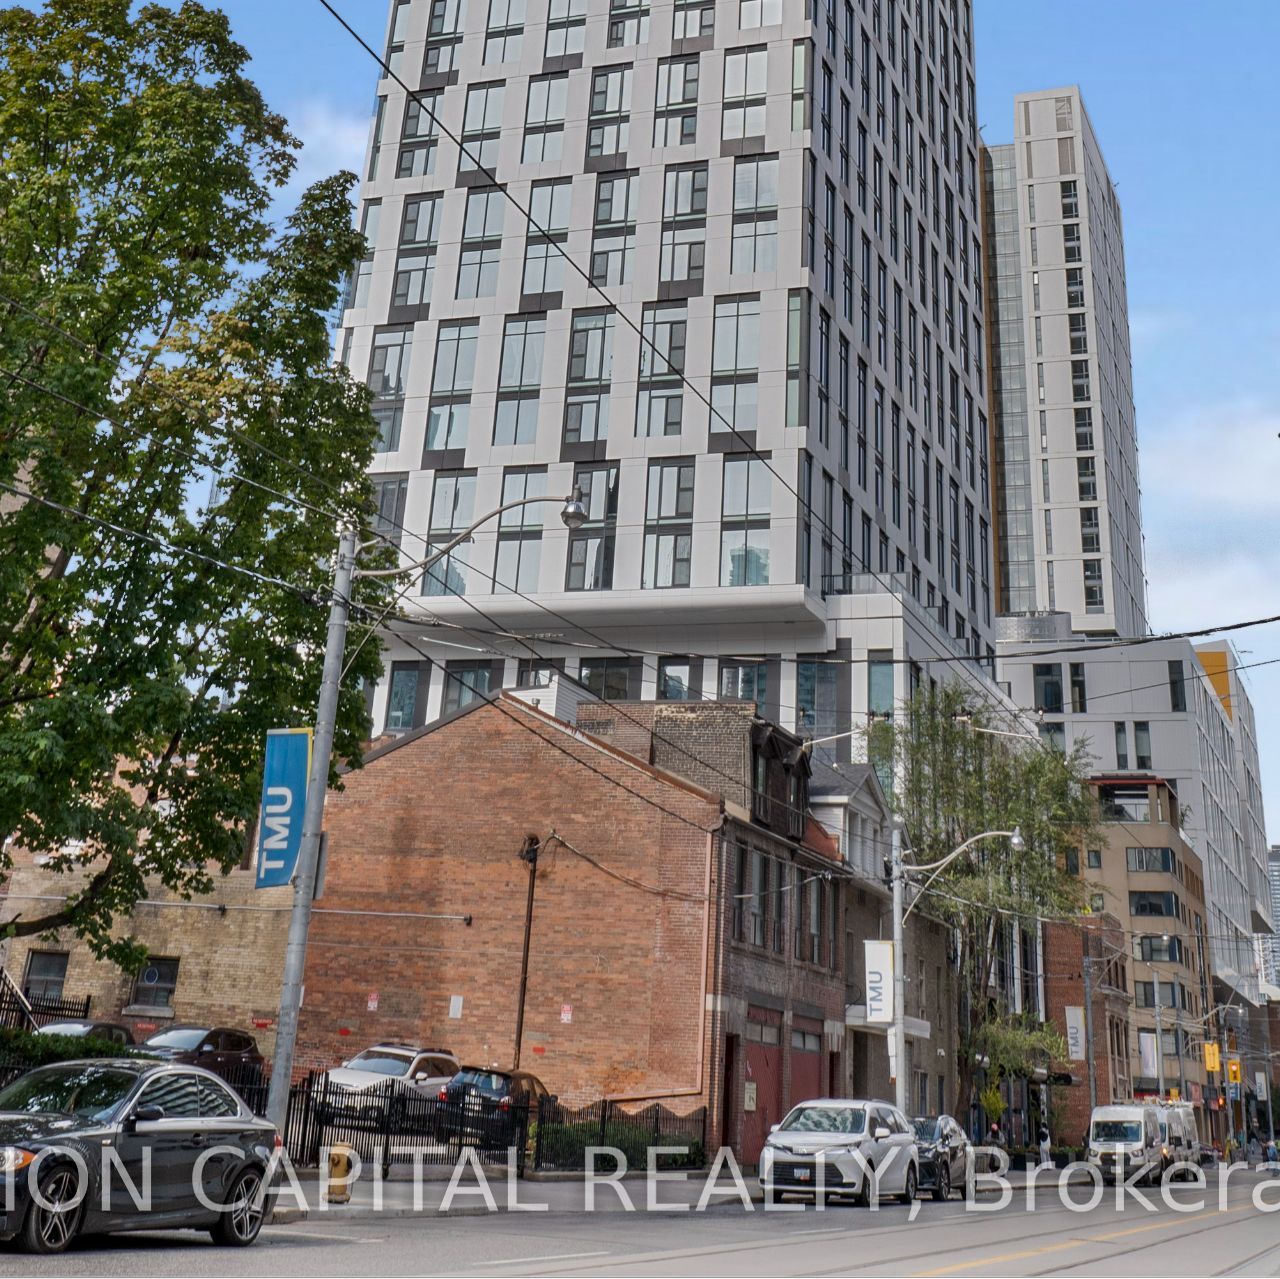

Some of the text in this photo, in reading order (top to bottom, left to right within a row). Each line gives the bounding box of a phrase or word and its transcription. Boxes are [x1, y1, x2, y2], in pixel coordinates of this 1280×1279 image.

[259, 786, 293, 879] TMU
[868, 971, 883, 1017] TMU
[1069, 1025, 1080, 1057] TMU
